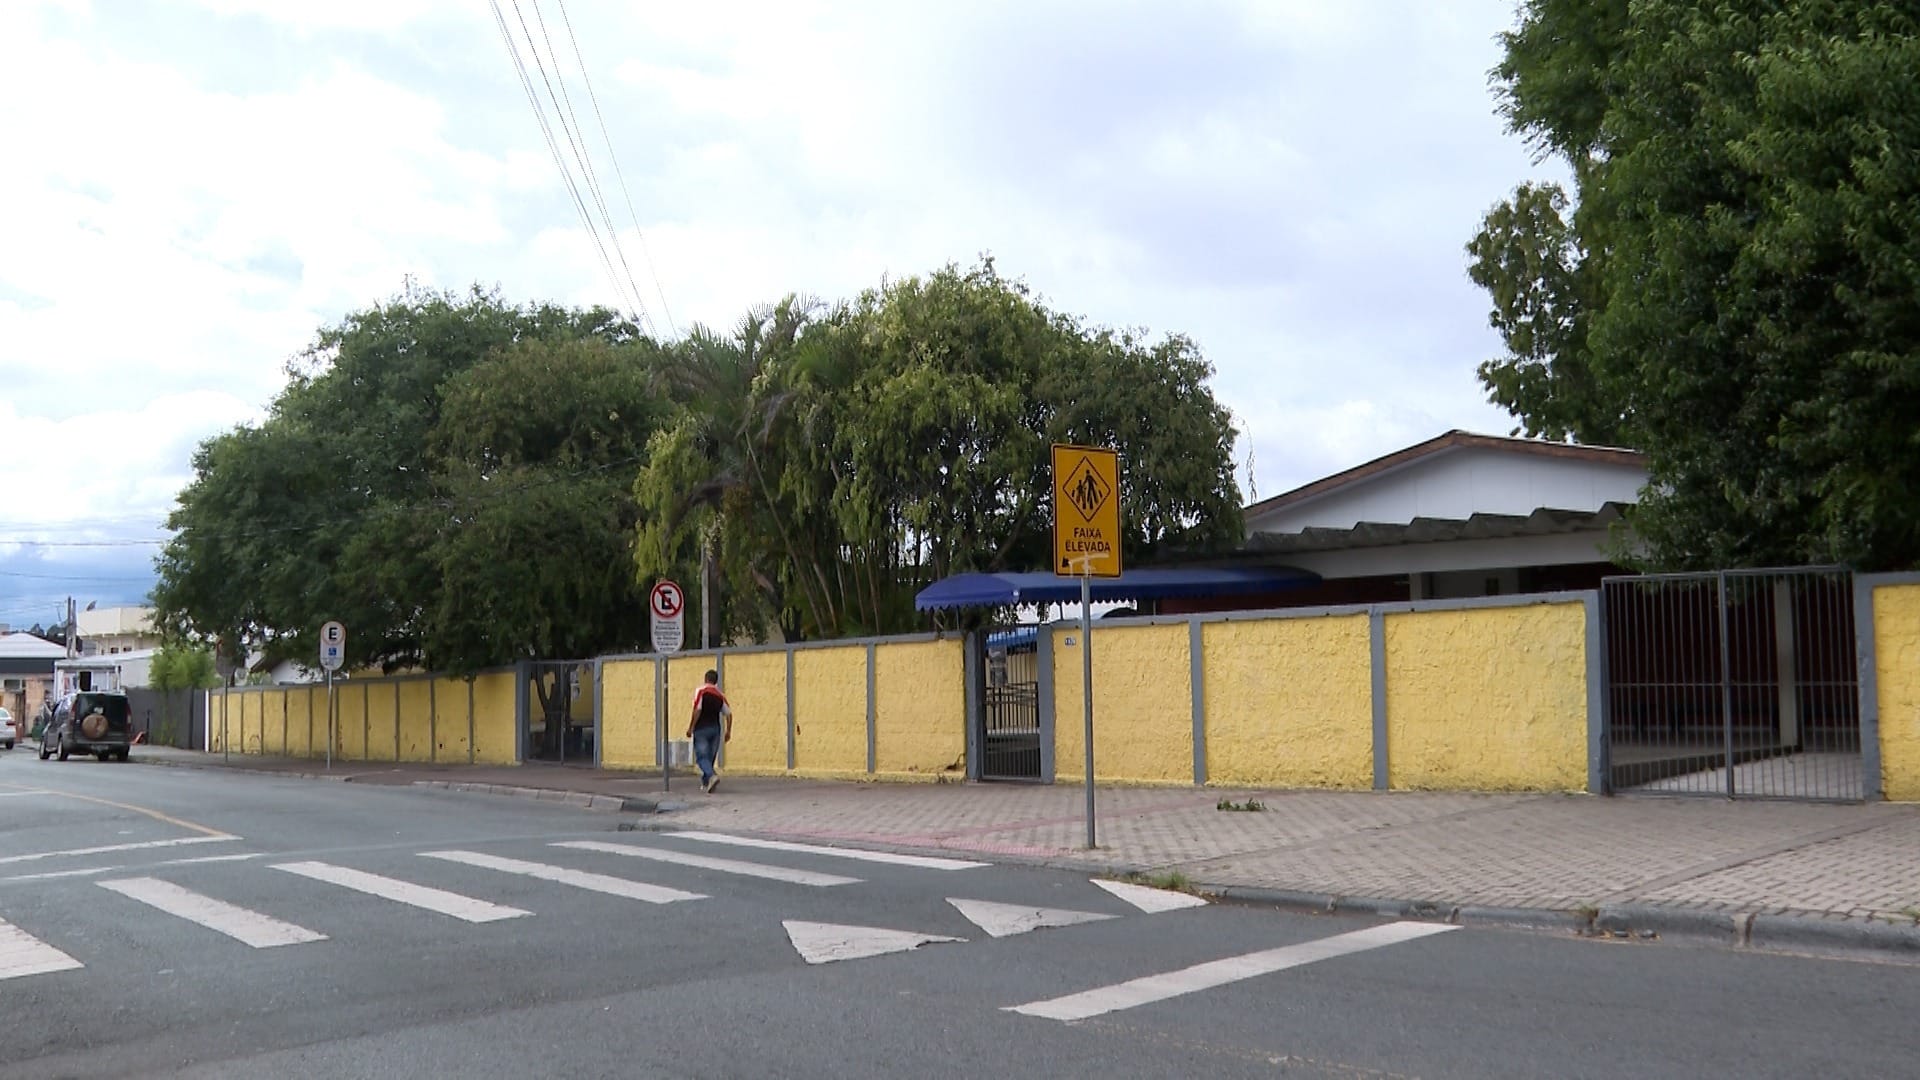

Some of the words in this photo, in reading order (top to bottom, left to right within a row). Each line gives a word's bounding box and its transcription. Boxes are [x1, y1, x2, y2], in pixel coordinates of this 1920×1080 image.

[1074, 528, 1102, 538] FAIXA
[1065, 541, 1111, 552] ELEVADA
[661, 589, 672, 609] E
[328, 627, 338, 640] E
